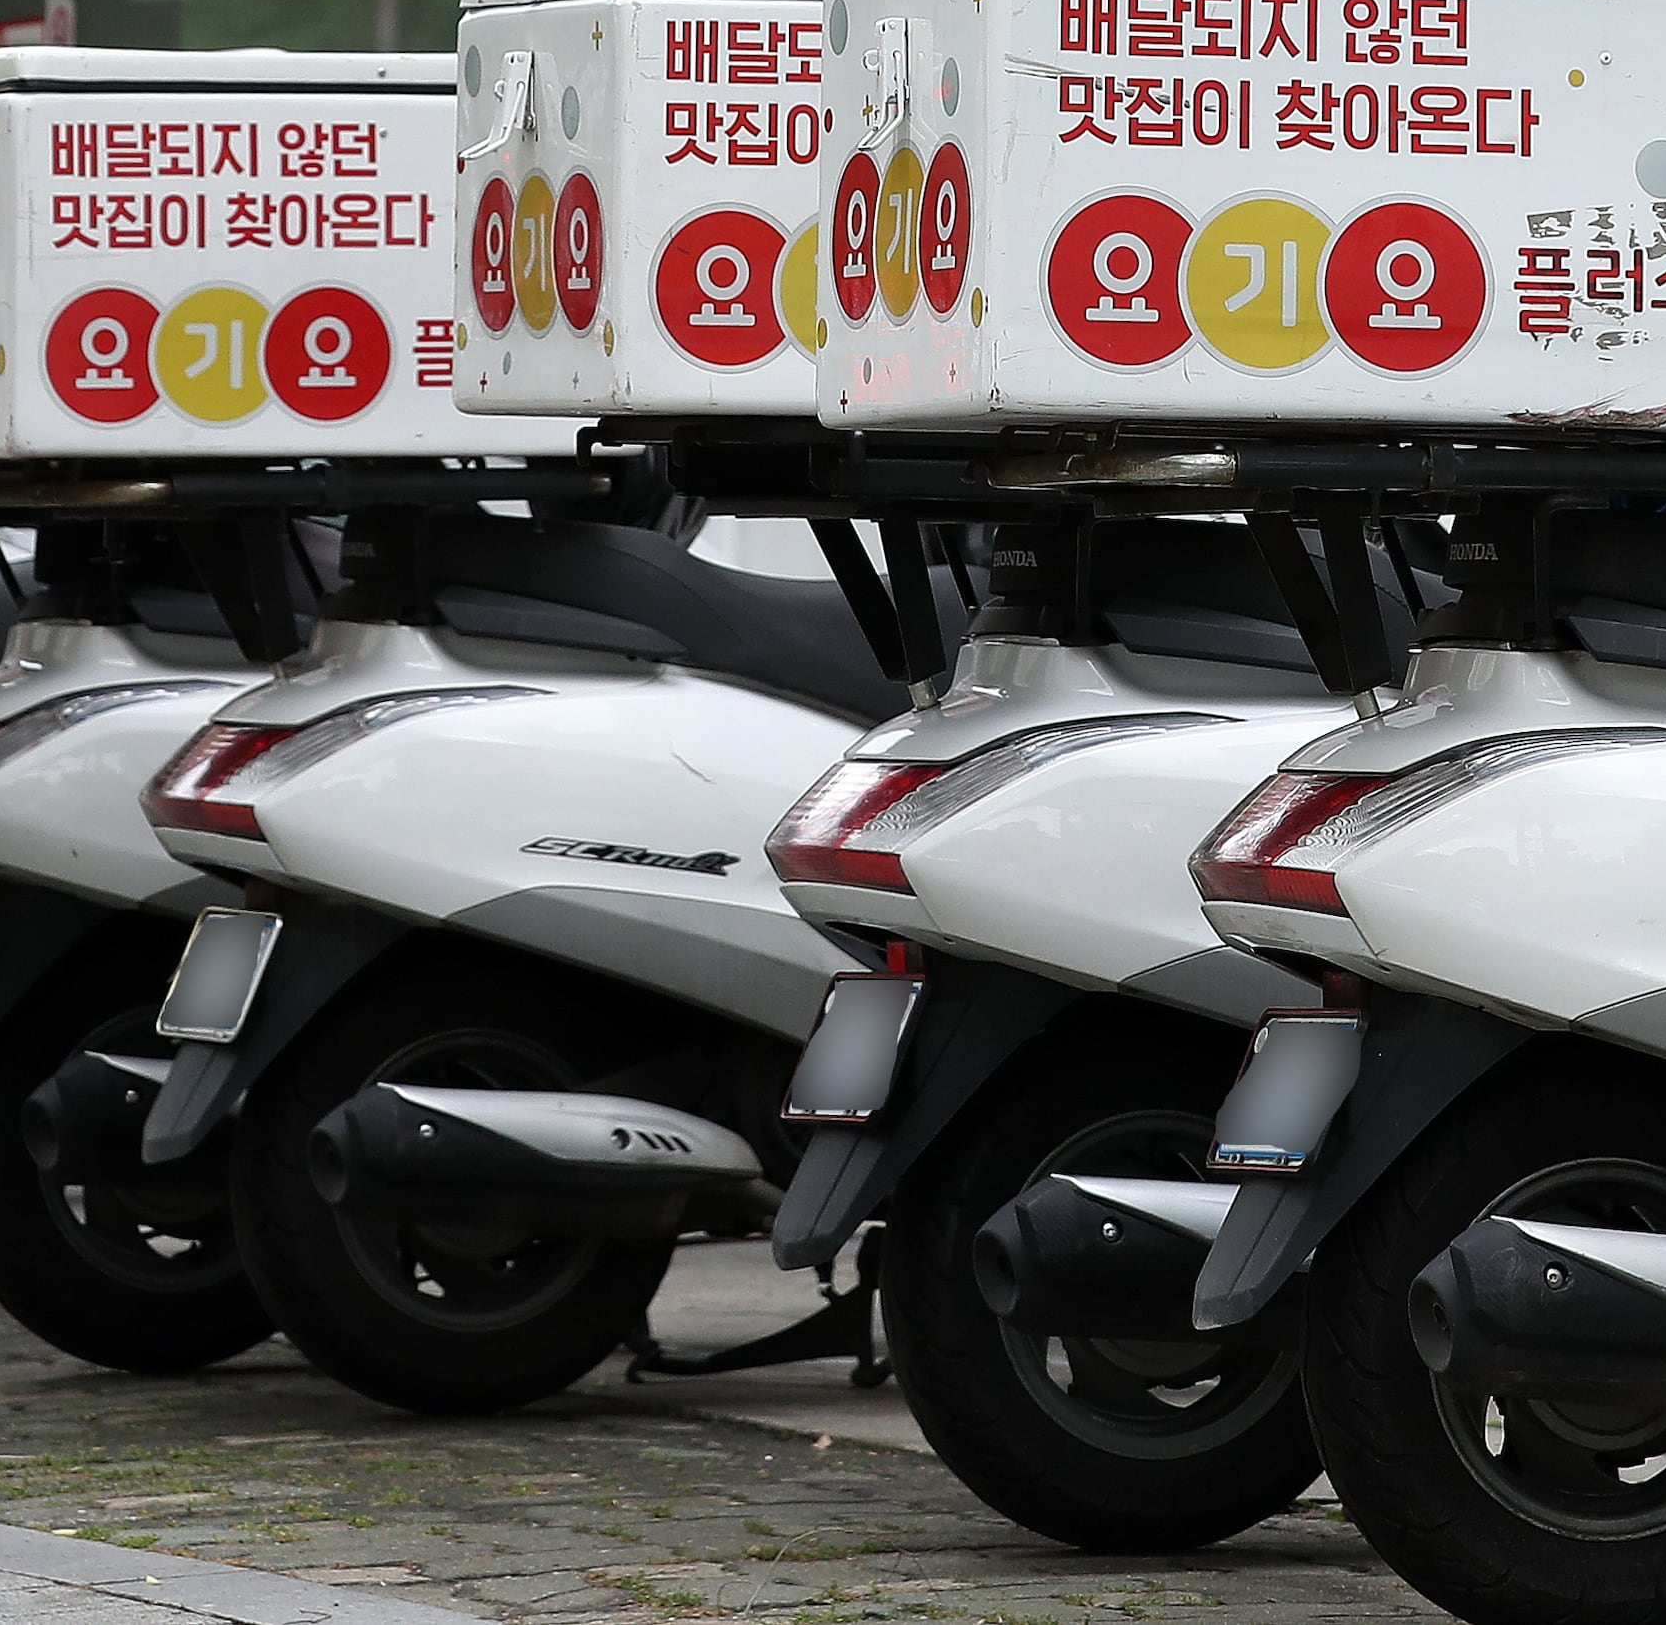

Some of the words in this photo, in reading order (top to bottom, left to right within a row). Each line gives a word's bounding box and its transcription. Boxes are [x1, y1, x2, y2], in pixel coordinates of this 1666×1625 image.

[1060, 76, 1252, 150] 맛집이
[1276, 79, 1541, 158] 찾아온다
[51, 123, 260, 179] 배달되지
[277, 122, 379, 179] 않던
[52, 194, 208, 250] 맛집이
[226, 192, 435, 249] 찾아온다
[992, 549, 1038, 568] HONDA
[1448, 542, 1499, 562] HONDA
